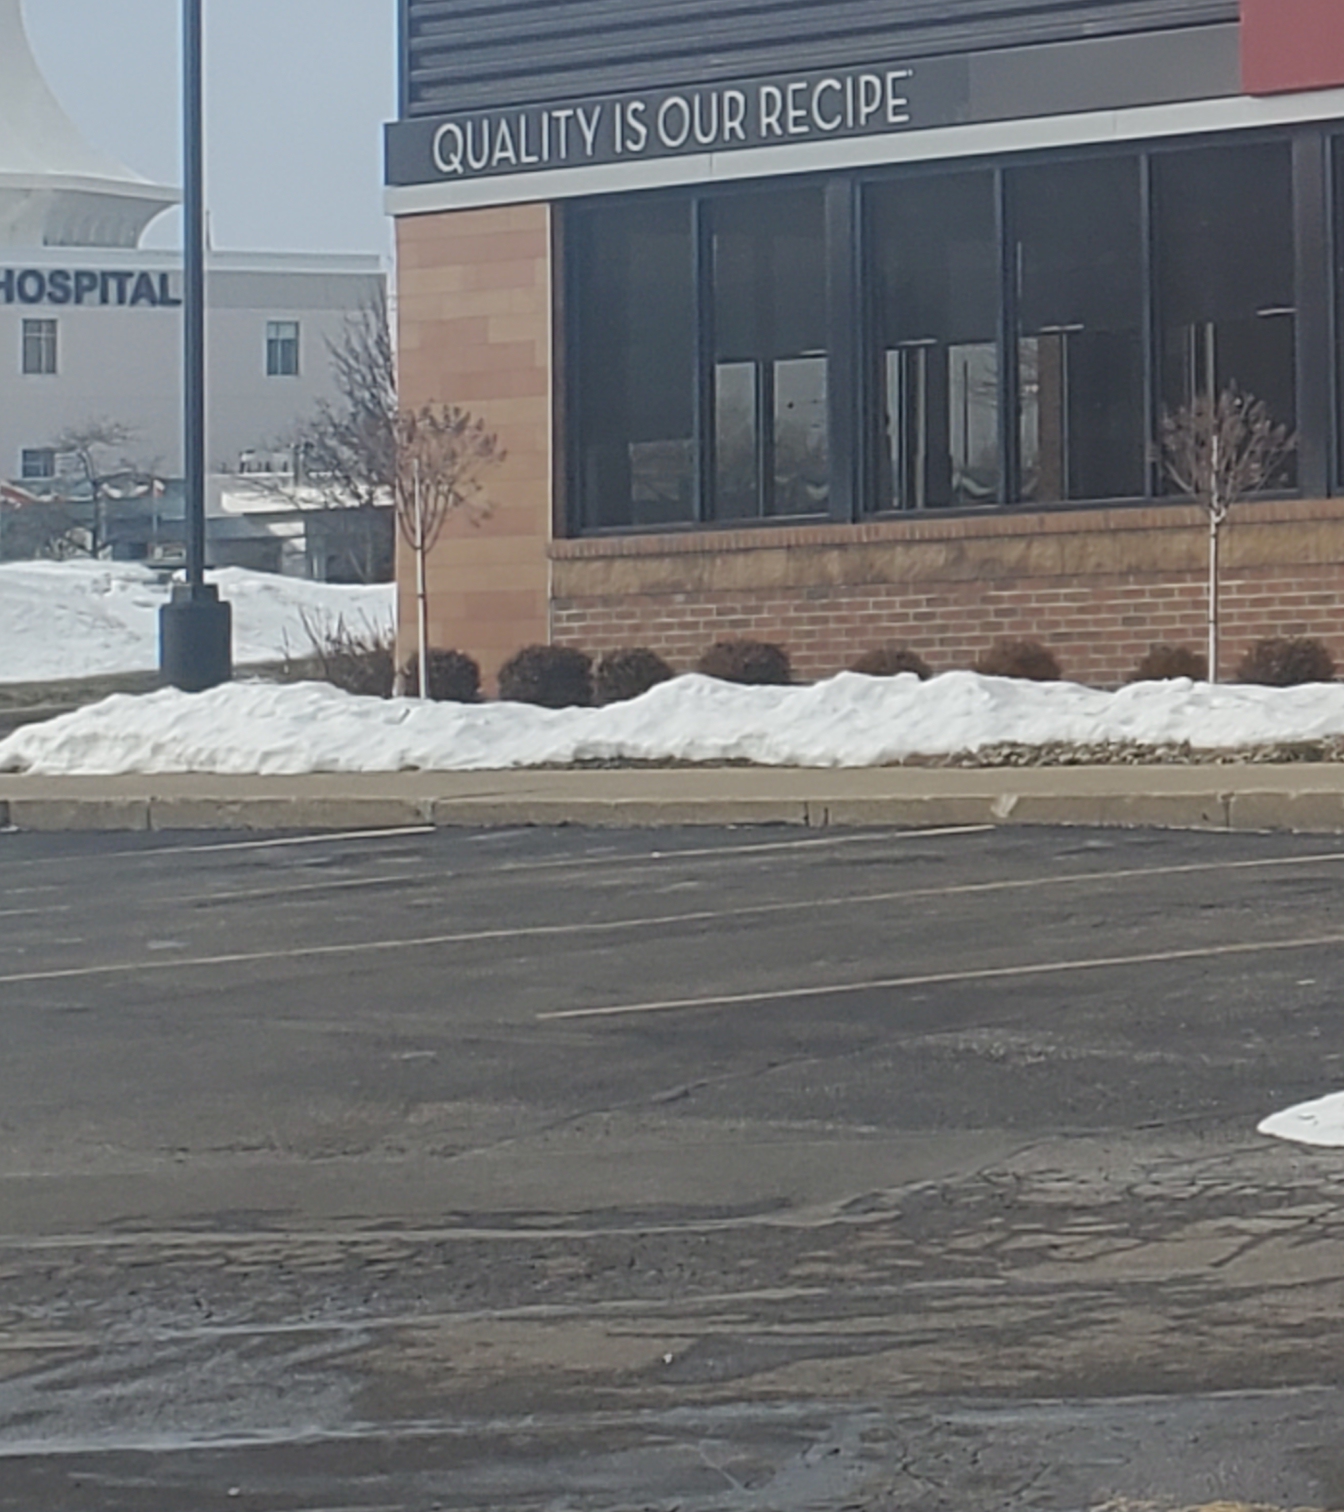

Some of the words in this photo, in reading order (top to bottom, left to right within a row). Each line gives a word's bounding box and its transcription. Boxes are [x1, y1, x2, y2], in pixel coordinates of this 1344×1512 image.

[432, 105, 601, 174] QUALITY
[614, 100, 647, 154] IS
[657, 89, 746, 148] OUR
[759, 70, 911, 138] RECIPE
